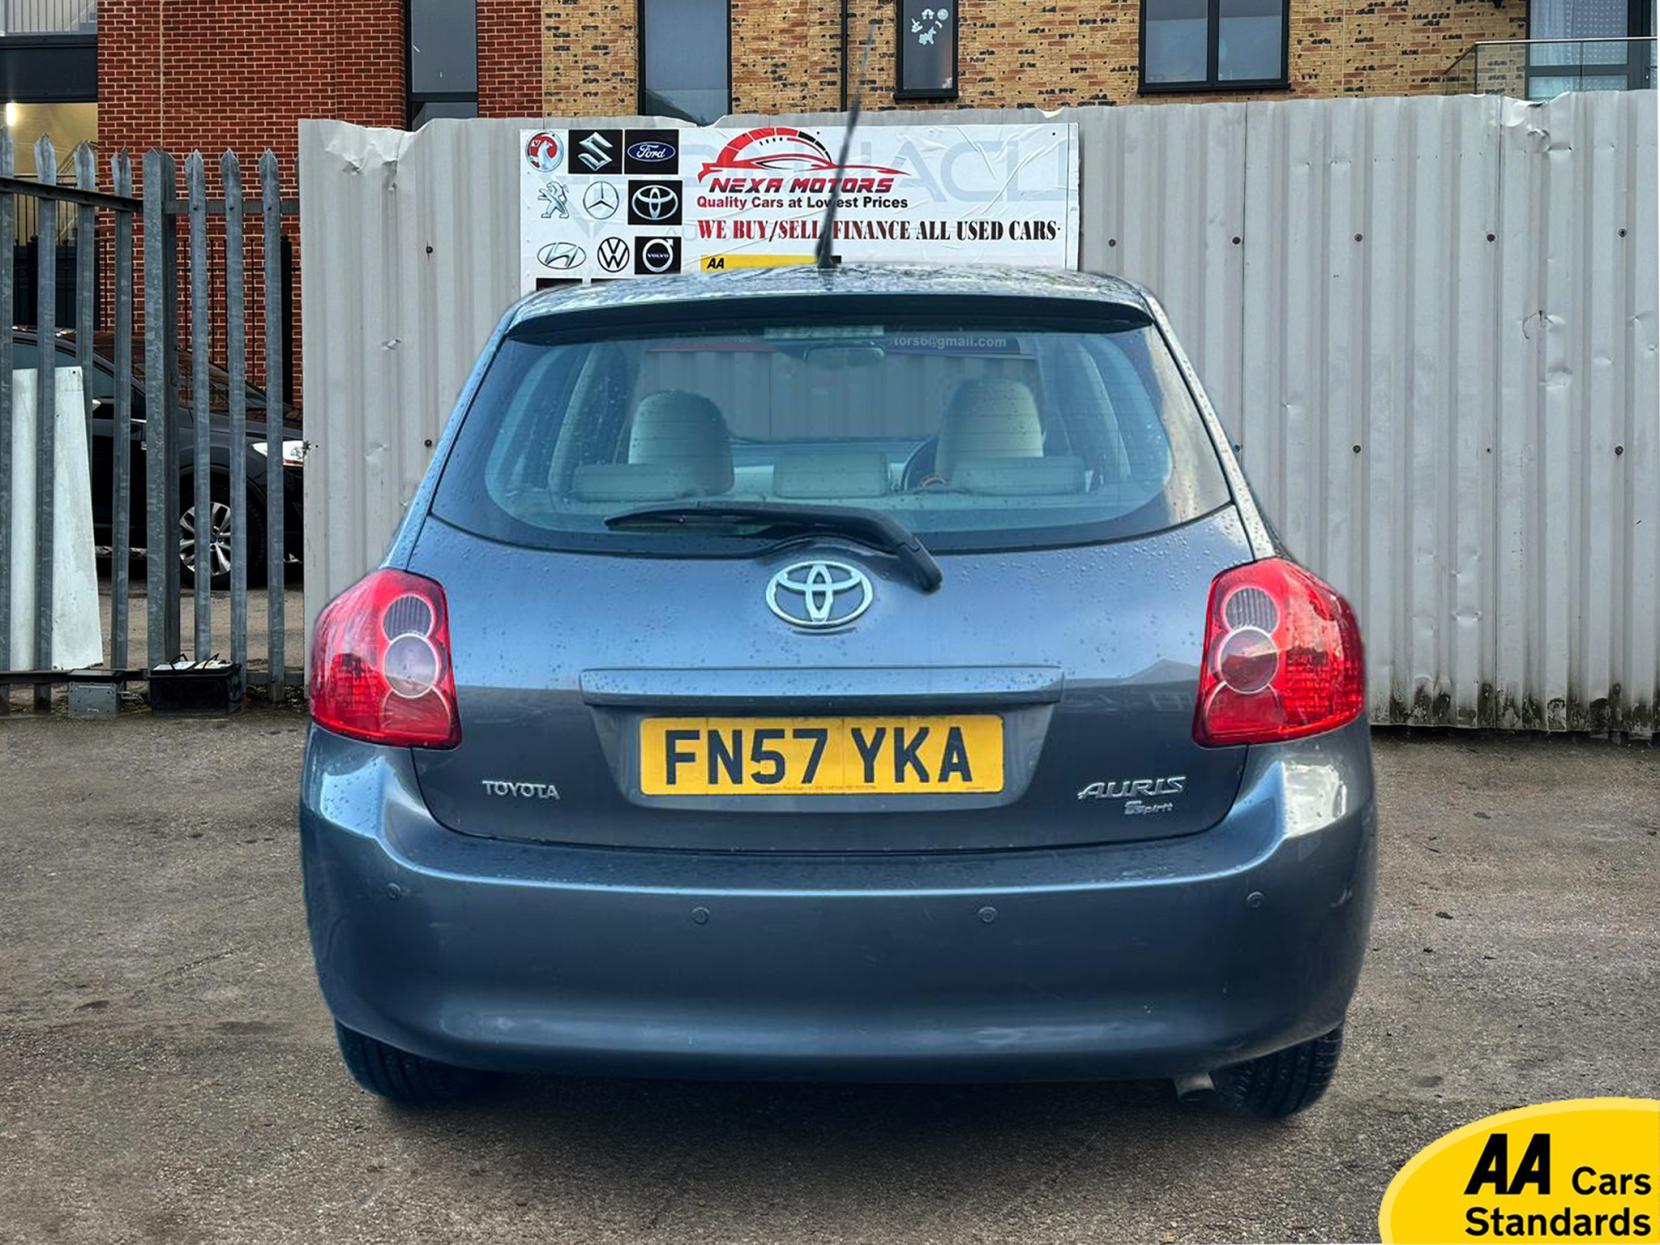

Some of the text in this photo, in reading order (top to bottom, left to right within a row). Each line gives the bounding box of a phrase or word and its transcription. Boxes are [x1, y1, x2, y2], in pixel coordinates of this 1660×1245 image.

[636, 144, 666, 159] Ford
[709, 177, 894, 193] NEXA MOTORS
[697, 195, 747, 210] Quality
[752, 196, 784, 208] Cars
[788, 197, 802, 208] at
[863, 196, 908, 208] Prices
[697, 219, 727, 239] WE
[833, 219, 910, 240] FINANCE
[916, 220, 950, 240] ALL
[957, 219, 1004, 240] USED
[1008, 219, 1057, 240] CARS
[706, 257, 725, 269] AA
[664, 726, 974, 785] FN57 YKA
[481, 780, 560, 800] TOYOTA
[1077, 776, 1186, 799] AURIS
